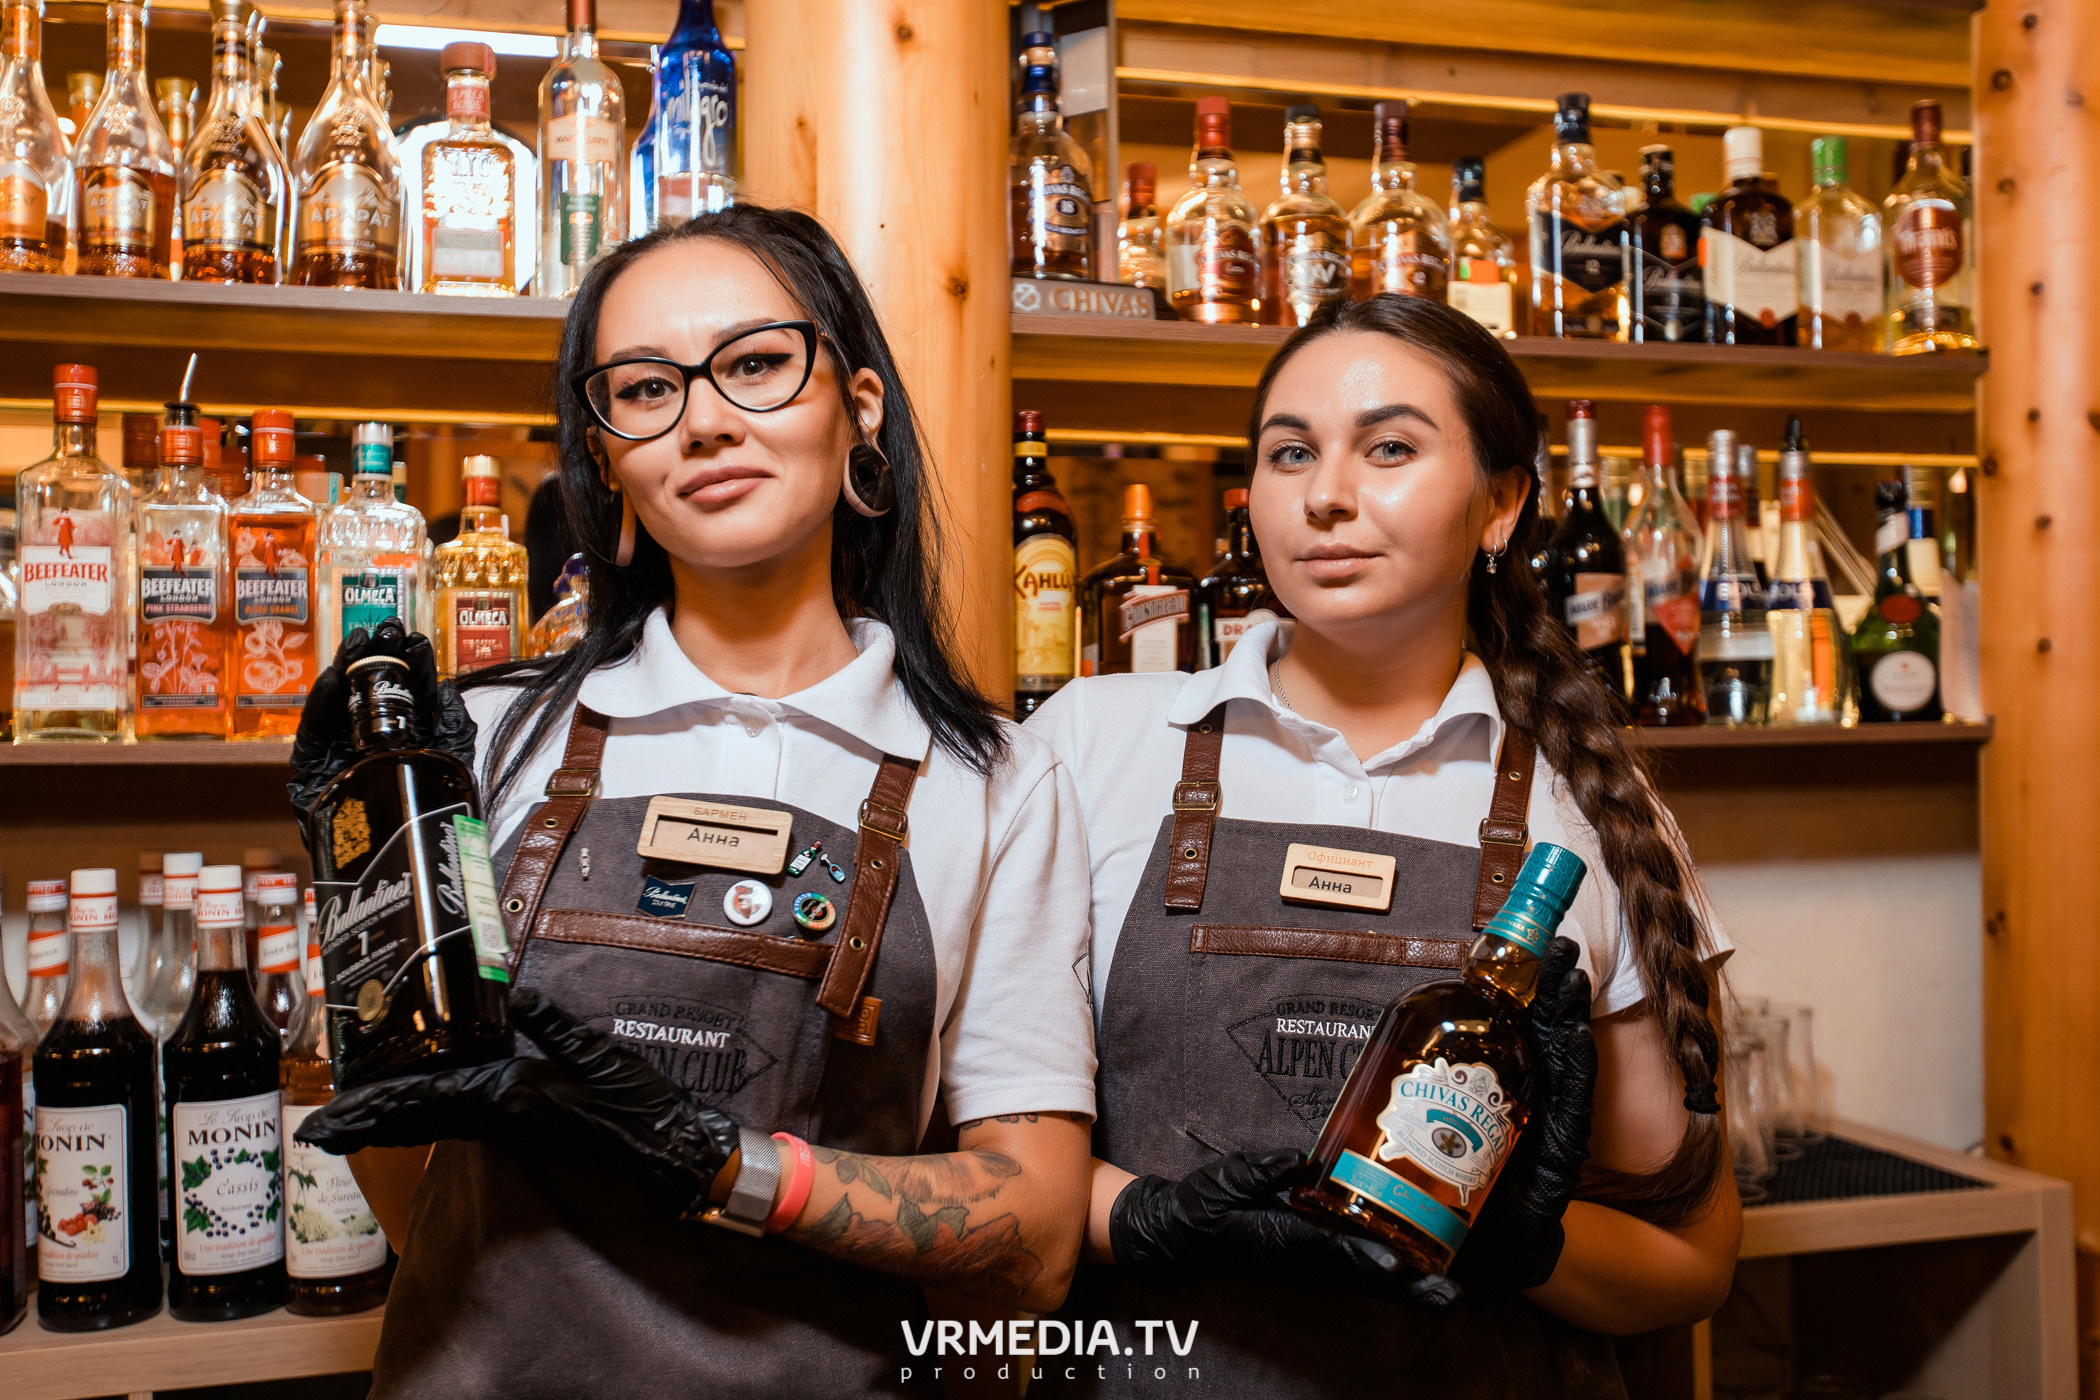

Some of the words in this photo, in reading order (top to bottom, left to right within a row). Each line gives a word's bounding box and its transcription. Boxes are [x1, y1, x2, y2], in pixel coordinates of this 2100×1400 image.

[1053, 286, 1150, 318] CHIVAS
[24, 562, 108, 583] BEEFEATER
[141, 578, 216, 599] BEEFEATER
[160, 594, 198, 602] LONDON
[236, 579, 309, 600] BEEFEATER
[344, 587, 395, 604] OLMECA
[145, 603, 163, 613] PINK
[166, 603, 212, 614] STRAWBERRY
[254, 595, 291, 604] LONDON
[459, 611, 507, 626] OLMECA
[693, 806, 747, 822] БАРМЕН
[687, 827, 740, 848] Анна
[1307, 850, 1374, 869] Официант
[1308, 875, 1352, 894] Анна
[317, 871, 413, 950] Ballantine's
[615, 1002, 670, 1017] GRAND
[1276, 1001, 1325, 1014] GRAND
[612, 1018, 731, 1049] RESTAURANT
[1256, 1029, 1336, 1081] ALPEN
[680, 1047, 749, 1094] CLUB
[1400, 1080, 1470, 1112] CHIVAS
[1470, 1103, 1505, 1157] REGAL
[188, 1118, 276, 1146] MONIN
[1396, 1130, 1427, 1159] BLENDED
[1428, 1156, 1455, 1177] SCOTCH
[1455, 1170, 1478, 1184] WHISKY
[216, 1178, 260, 1196] Cassis
